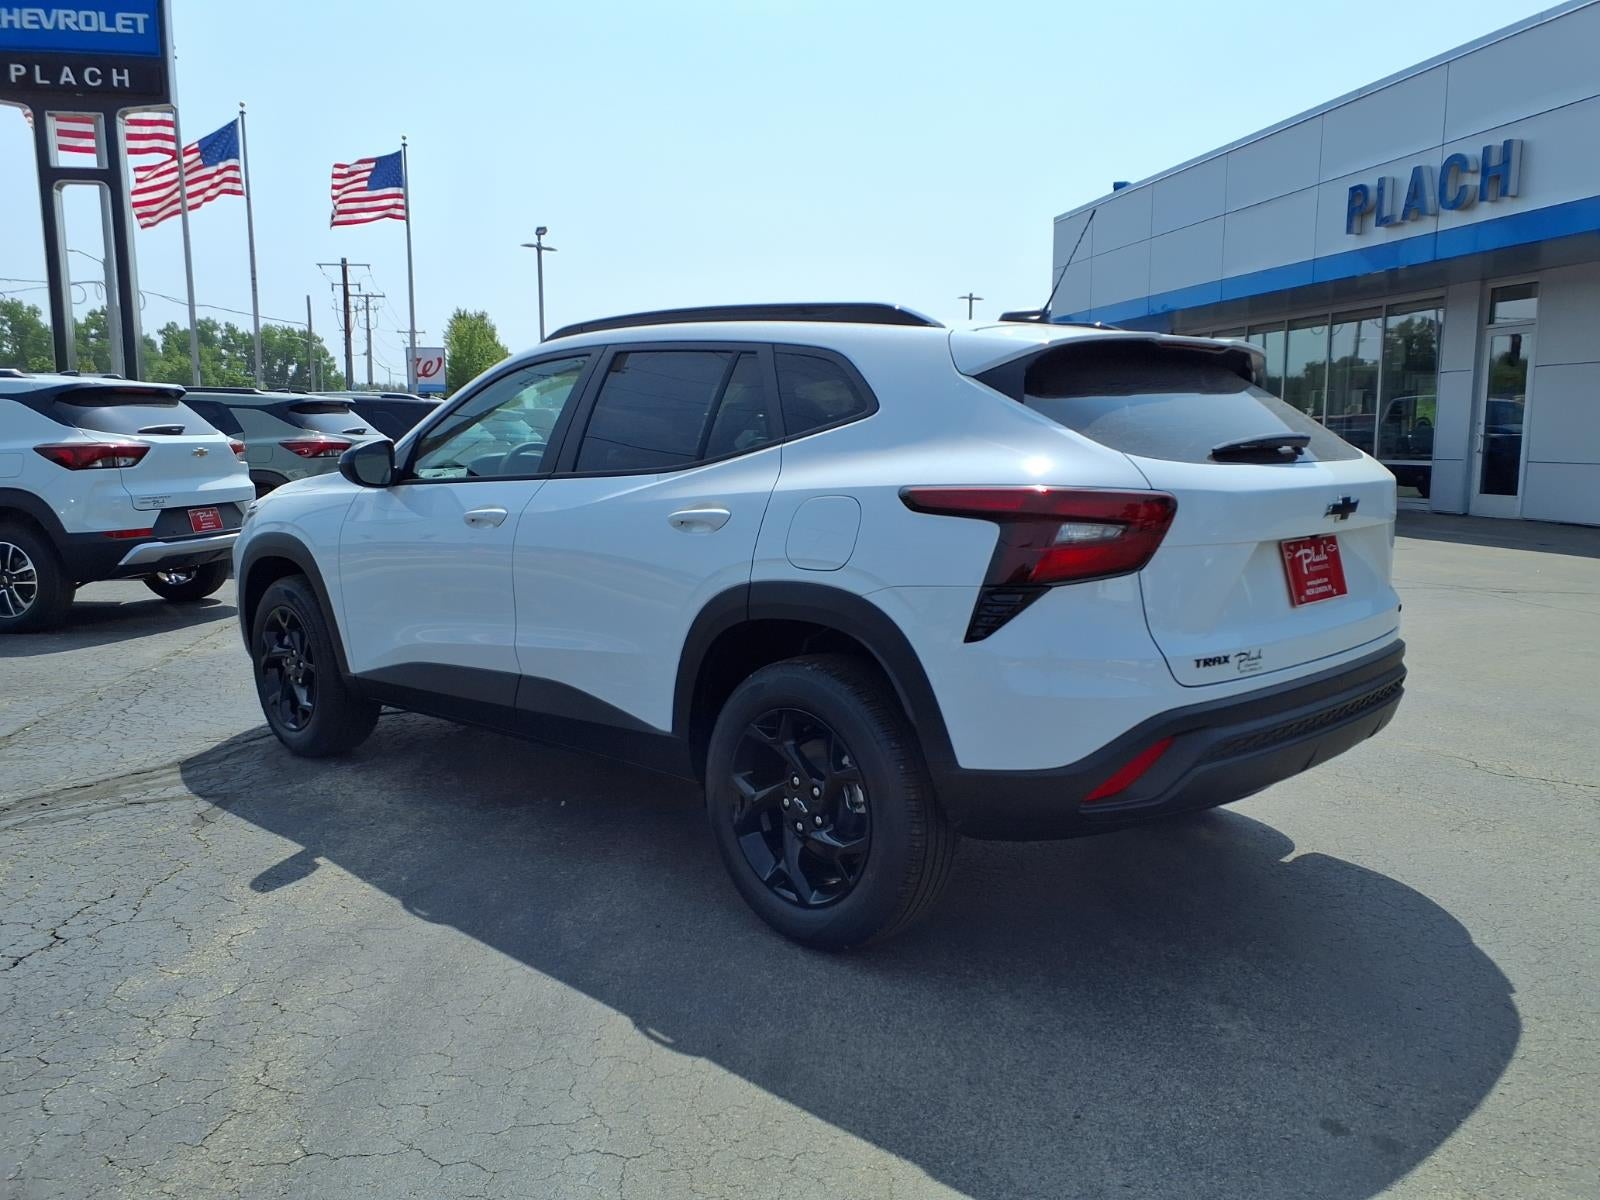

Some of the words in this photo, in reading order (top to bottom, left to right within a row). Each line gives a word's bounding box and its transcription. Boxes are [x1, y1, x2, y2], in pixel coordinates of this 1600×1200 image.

[0, 7, 149, 34] HEVROLET
[9, 63, 130, 88] PLACH
[1346, 139, 1524, 235] PLACH
[1194, 653, 1231, 669] TRAX
